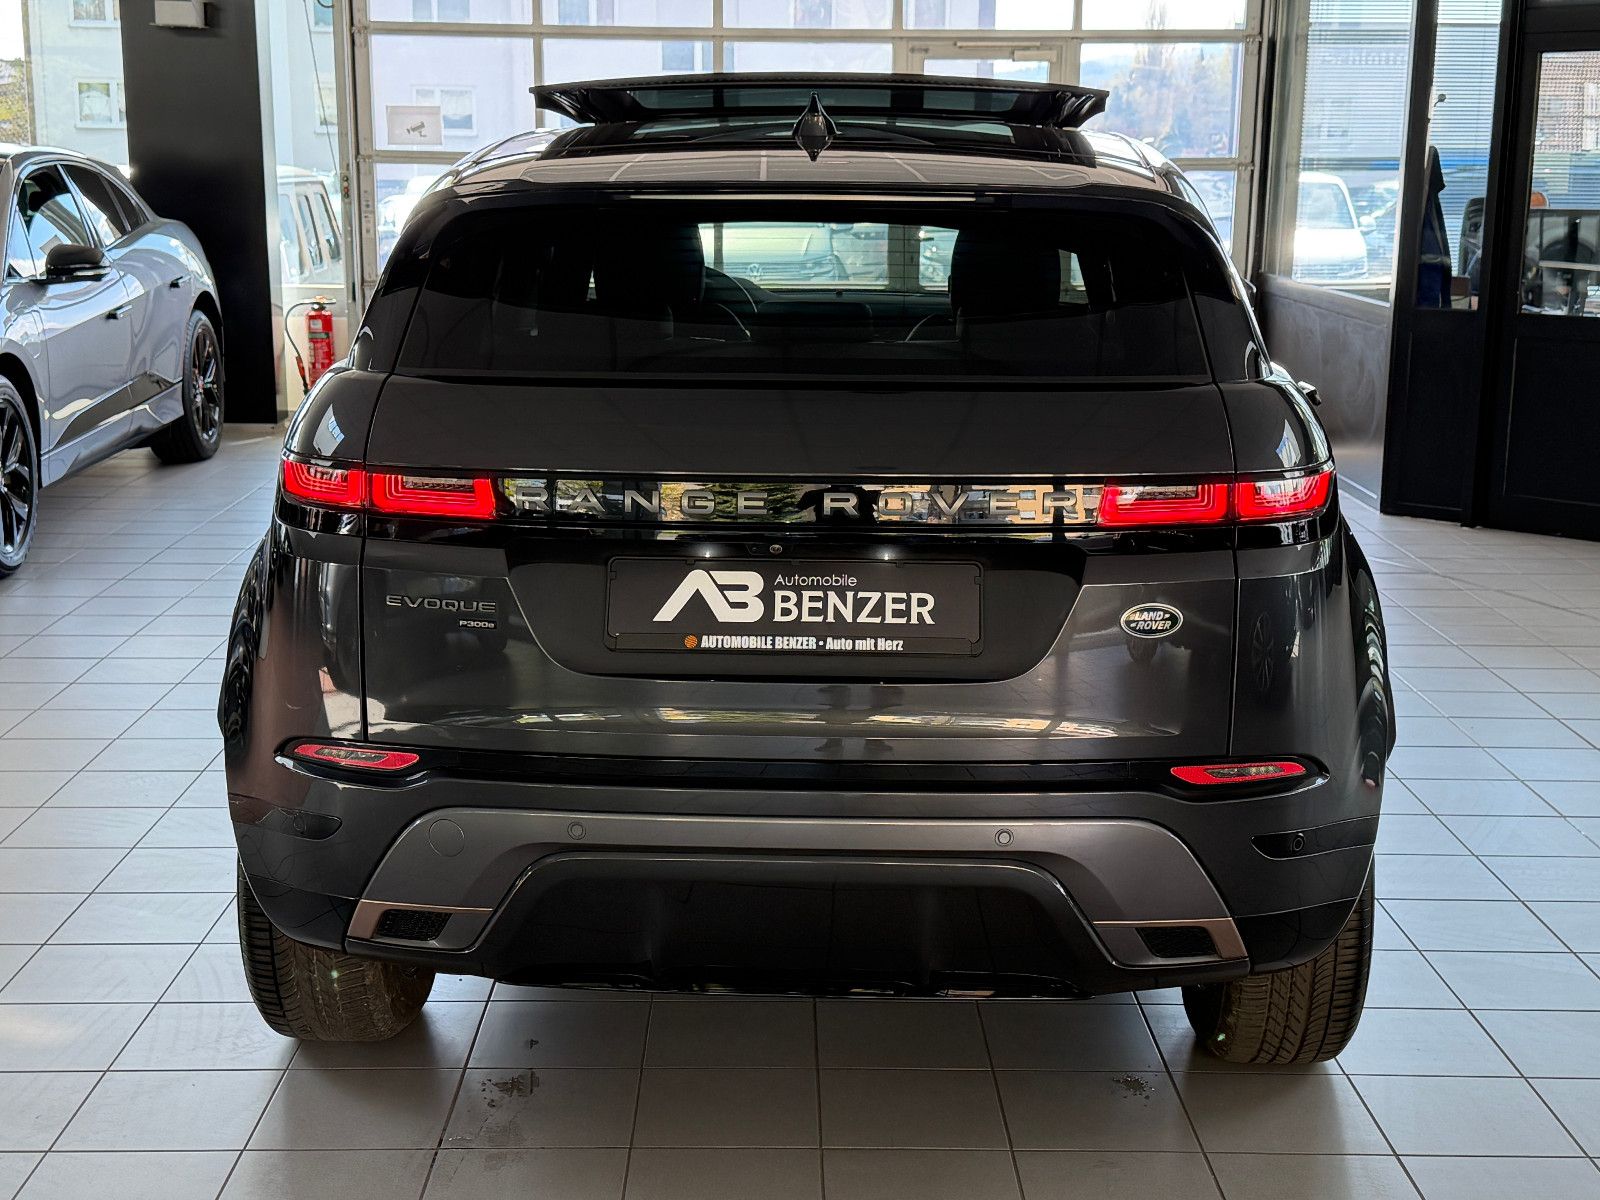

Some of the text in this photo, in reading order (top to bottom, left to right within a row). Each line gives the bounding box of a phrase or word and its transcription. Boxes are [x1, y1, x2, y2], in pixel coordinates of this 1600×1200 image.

[515, 486, 1077, 516] RANGE ROVER
[774, 574, 857, 587] Automobile
[386, 595, 496, 612] EVOQUE
[773, 591, 935, 624] BENZER
[1135, 611, 1164, 620] LAND
[459, 620, 495, 629] P300e
[1136, 621, 1172, 630] ROVER
[700, 635, 904, 651] AUTOMOBILE BENZER Auto mit Herz
